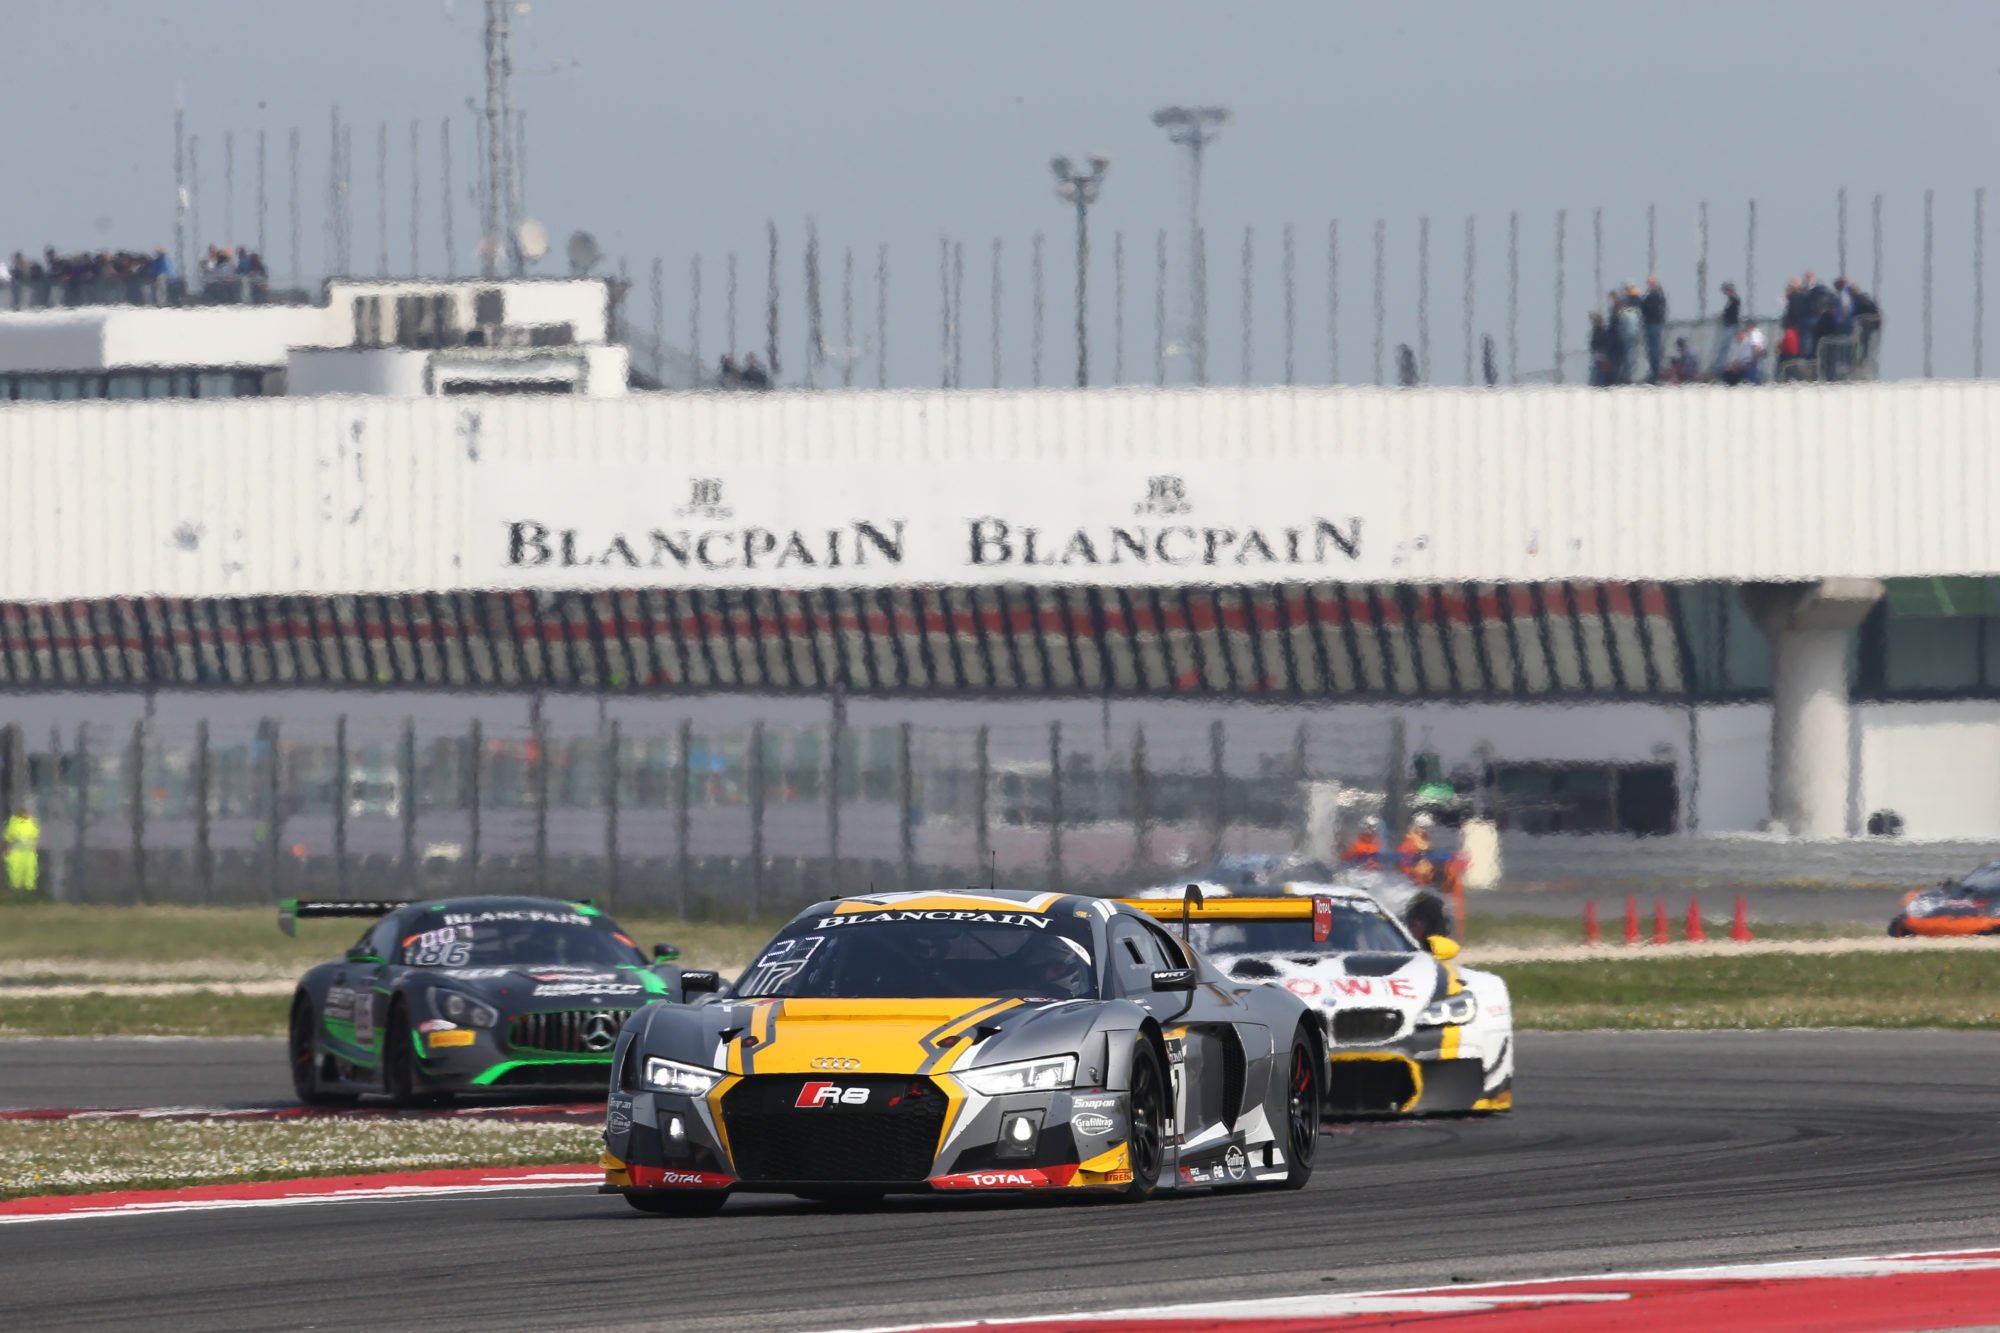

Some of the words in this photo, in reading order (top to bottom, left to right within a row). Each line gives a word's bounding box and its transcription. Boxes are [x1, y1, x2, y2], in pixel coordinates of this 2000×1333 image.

[502, 519, 905, 569] BLANCPAIN
[967, 516, 1365, 566] BLANCPAIN
[1316, 900, 1331, 914] TOTAL
[444, 911, 592, 926] BLANCPAIN
[814, 911, 1054, 930] BLANCPAIN
[1073, 1099, 1116, 1109] Snap-on
[1076, 1118, 1114, 1127] GrafiWrap
[663, 1172, 702, 1183] TOTAL
[967, 1174, 1032, 1185] TOTAL
